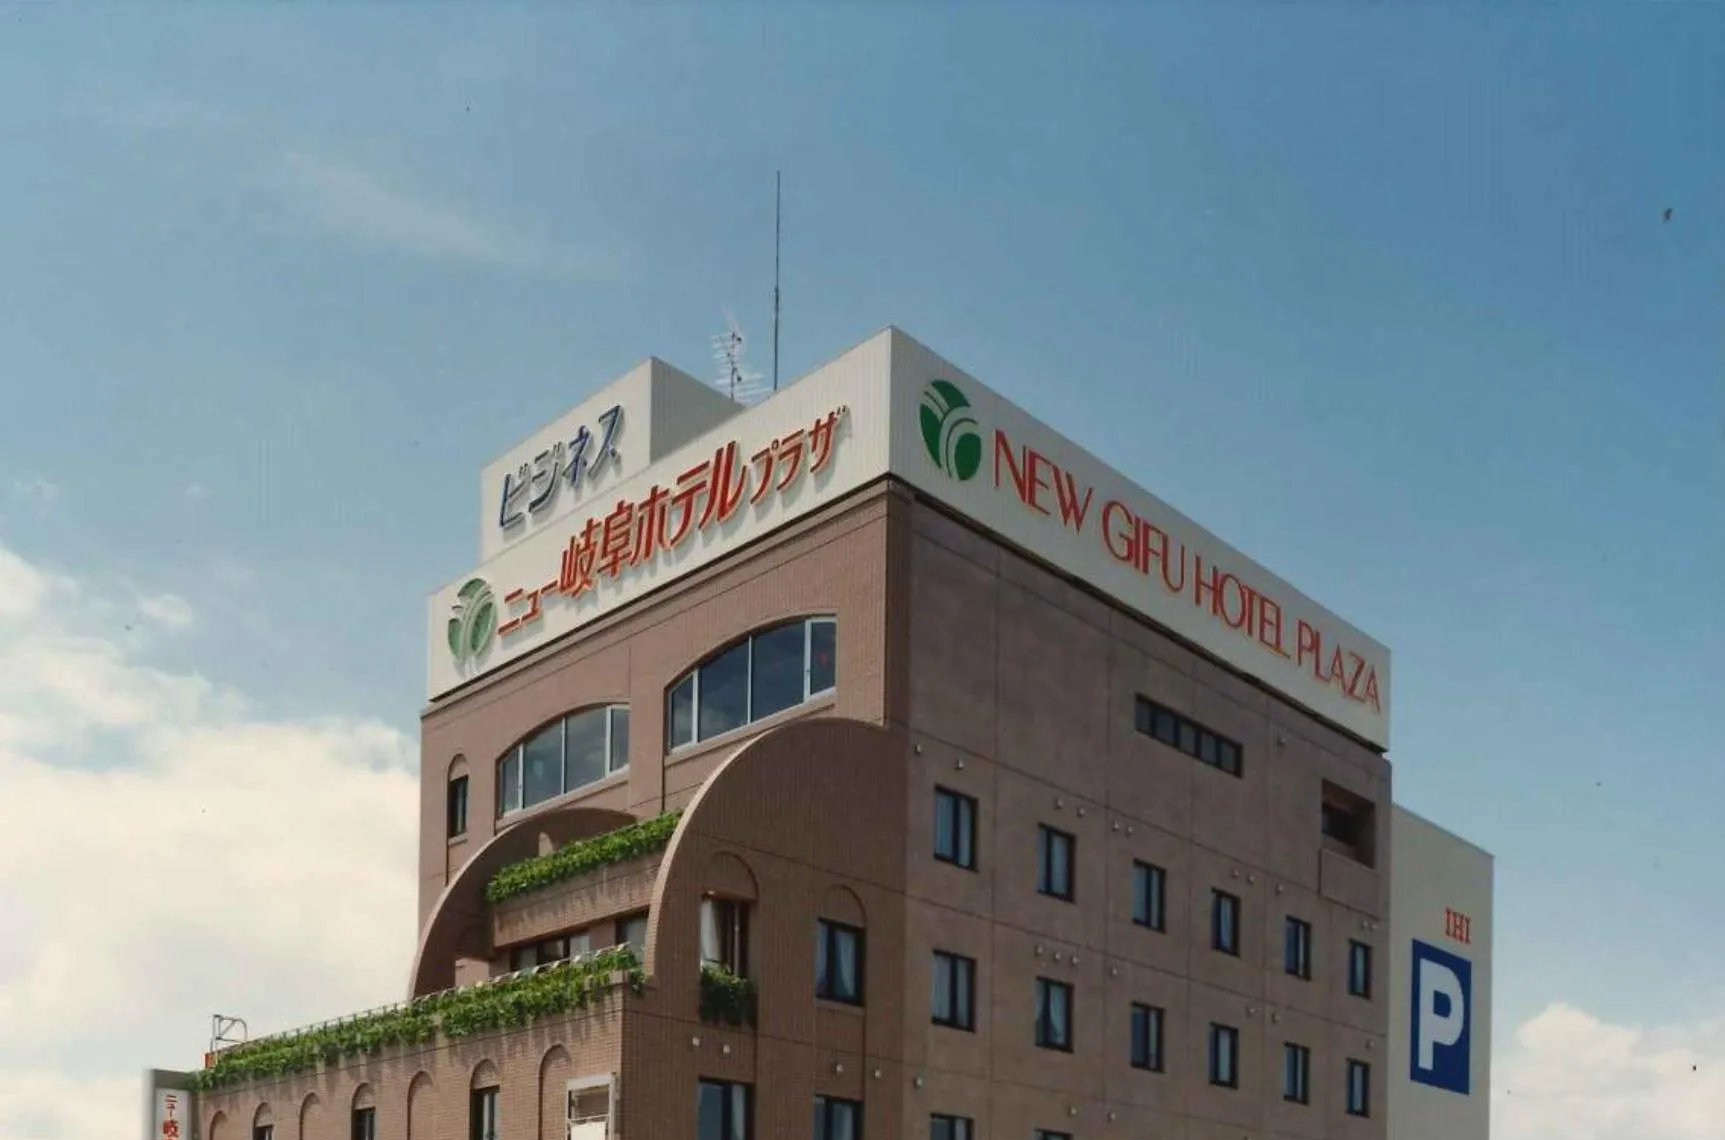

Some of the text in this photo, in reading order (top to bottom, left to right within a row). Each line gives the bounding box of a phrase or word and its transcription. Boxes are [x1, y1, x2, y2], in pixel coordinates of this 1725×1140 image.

[498, 405, 850, 636] ニュー岐阜ホテルプラザ
[499, 404, 623, 528] ビジネス
[993, 429, 1381, 713] NEW GIFU HOTEL PLAZA
[1417, 956, 1465, 1071] P
